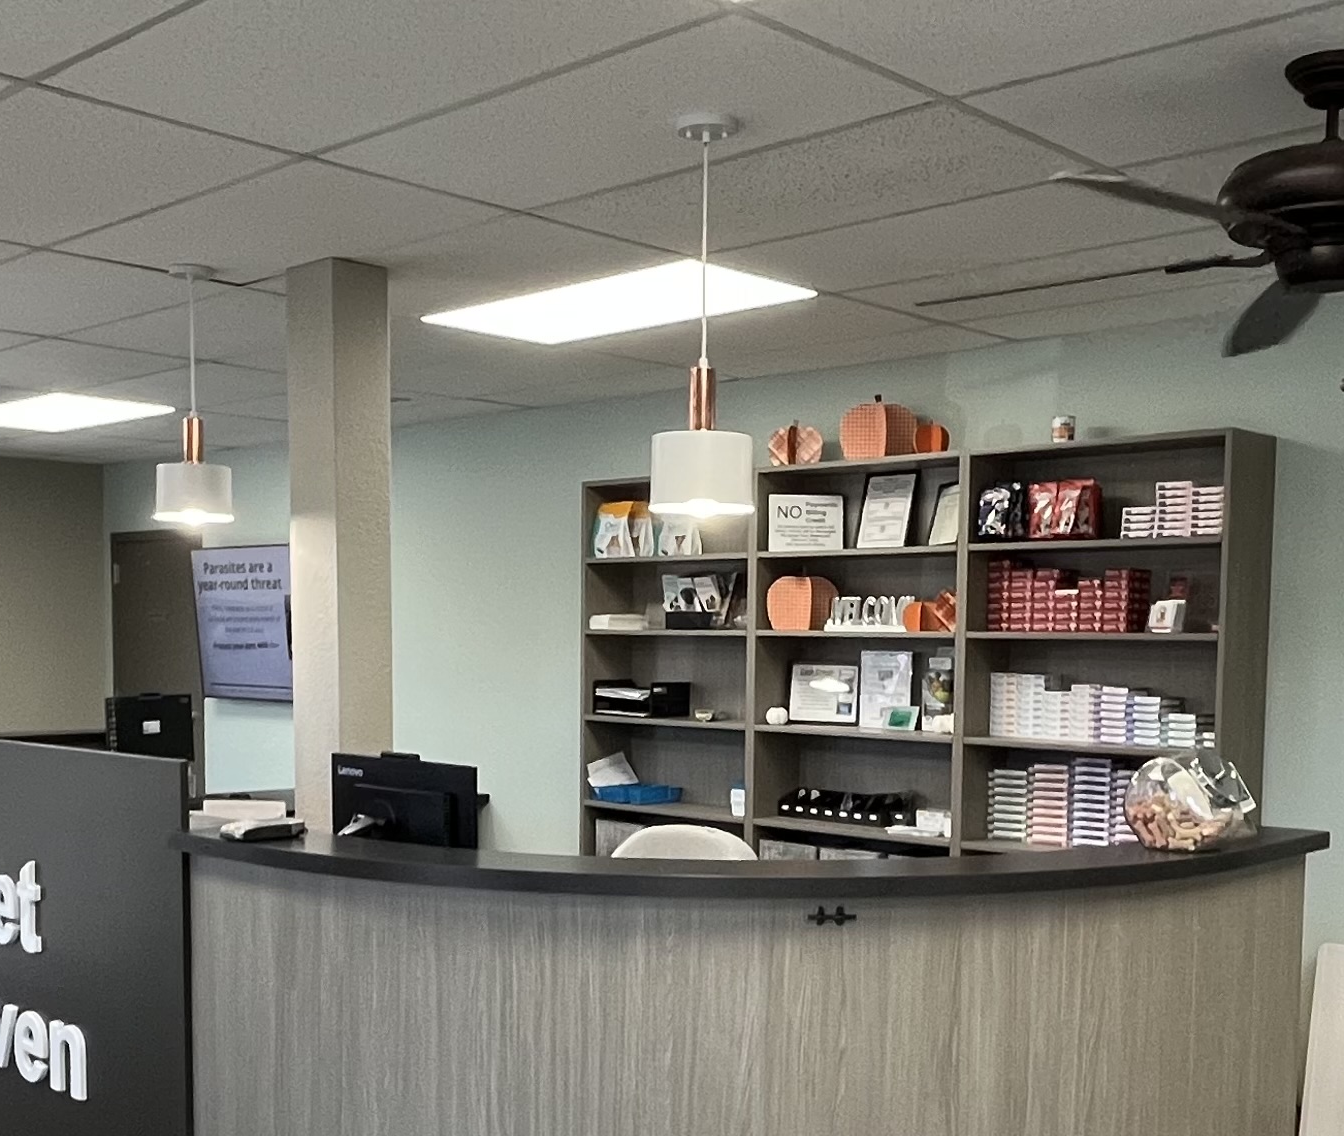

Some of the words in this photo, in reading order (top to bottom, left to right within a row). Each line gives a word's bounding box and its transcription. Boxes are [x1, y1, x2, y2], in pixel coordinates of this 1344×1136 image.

[777, 505, 803, 519] NO
[203, 561, 247, 575] Parasites
[248, 562, 265, 573] are
[266, 562, 273, 573] a
[198, 577, 249, 595] year-round
[251, 576, 283, 590] threat
[827, 595, 915, 626] WELCOM
[337, 764, 364, 777] Lenovo
